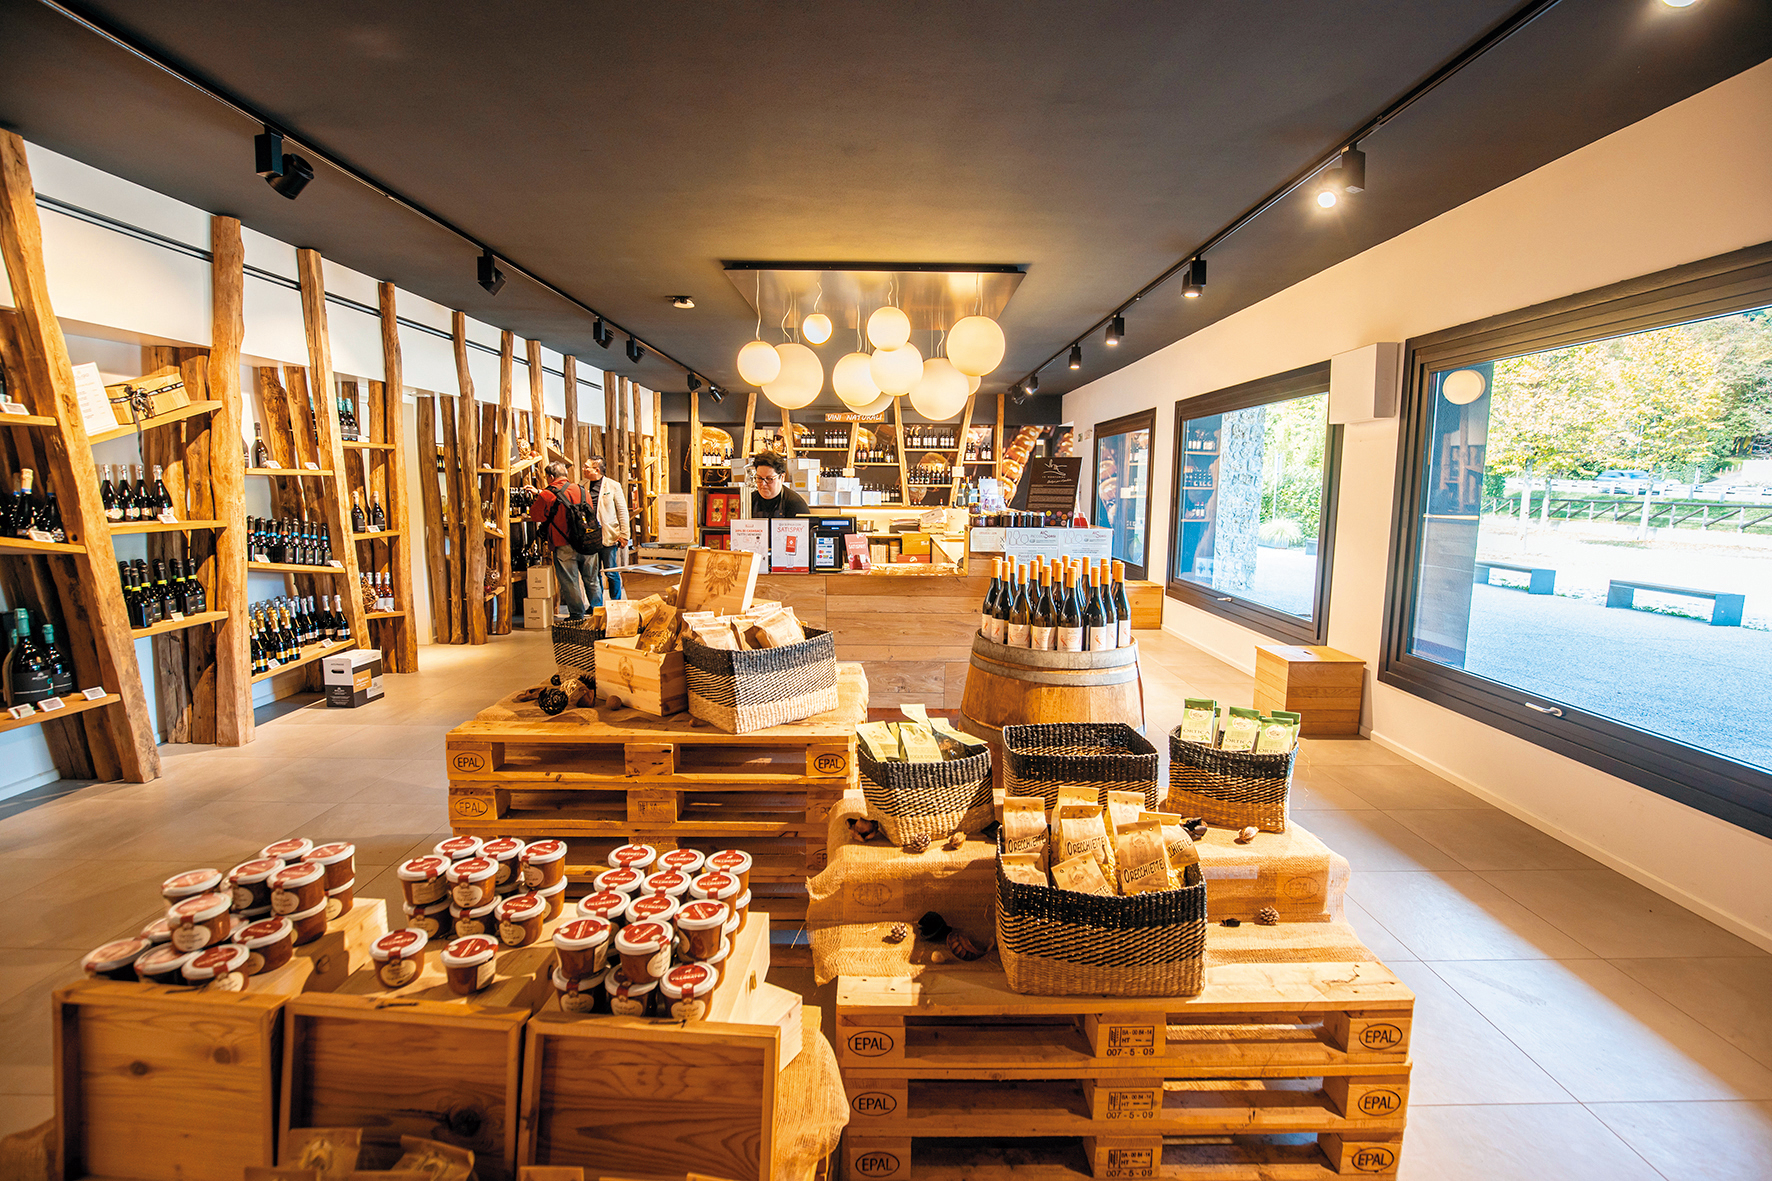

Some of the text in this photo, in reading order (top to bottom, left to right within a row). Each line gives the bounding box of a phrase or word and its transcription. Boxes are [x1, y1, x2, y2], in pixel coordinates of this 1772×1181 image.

[457, 757, 480, 767] EPAL
[818, 759, 841, 769] EPAL
[459, 802, 483, 813] EPAL
[1124, 859, 1165, 884] ORECCHIETTE
[1365, 1030, 1396, 1043] EPAL
[854, 1037, 887, 1050] EPAL
[858, 1098, 890, 1110] EPAL
[1364, 1096, 1394, 1110] EPAL
[861, 1158, 893, 1171] EPAL
[1358, 1153, 1388, 1166] EPAL
